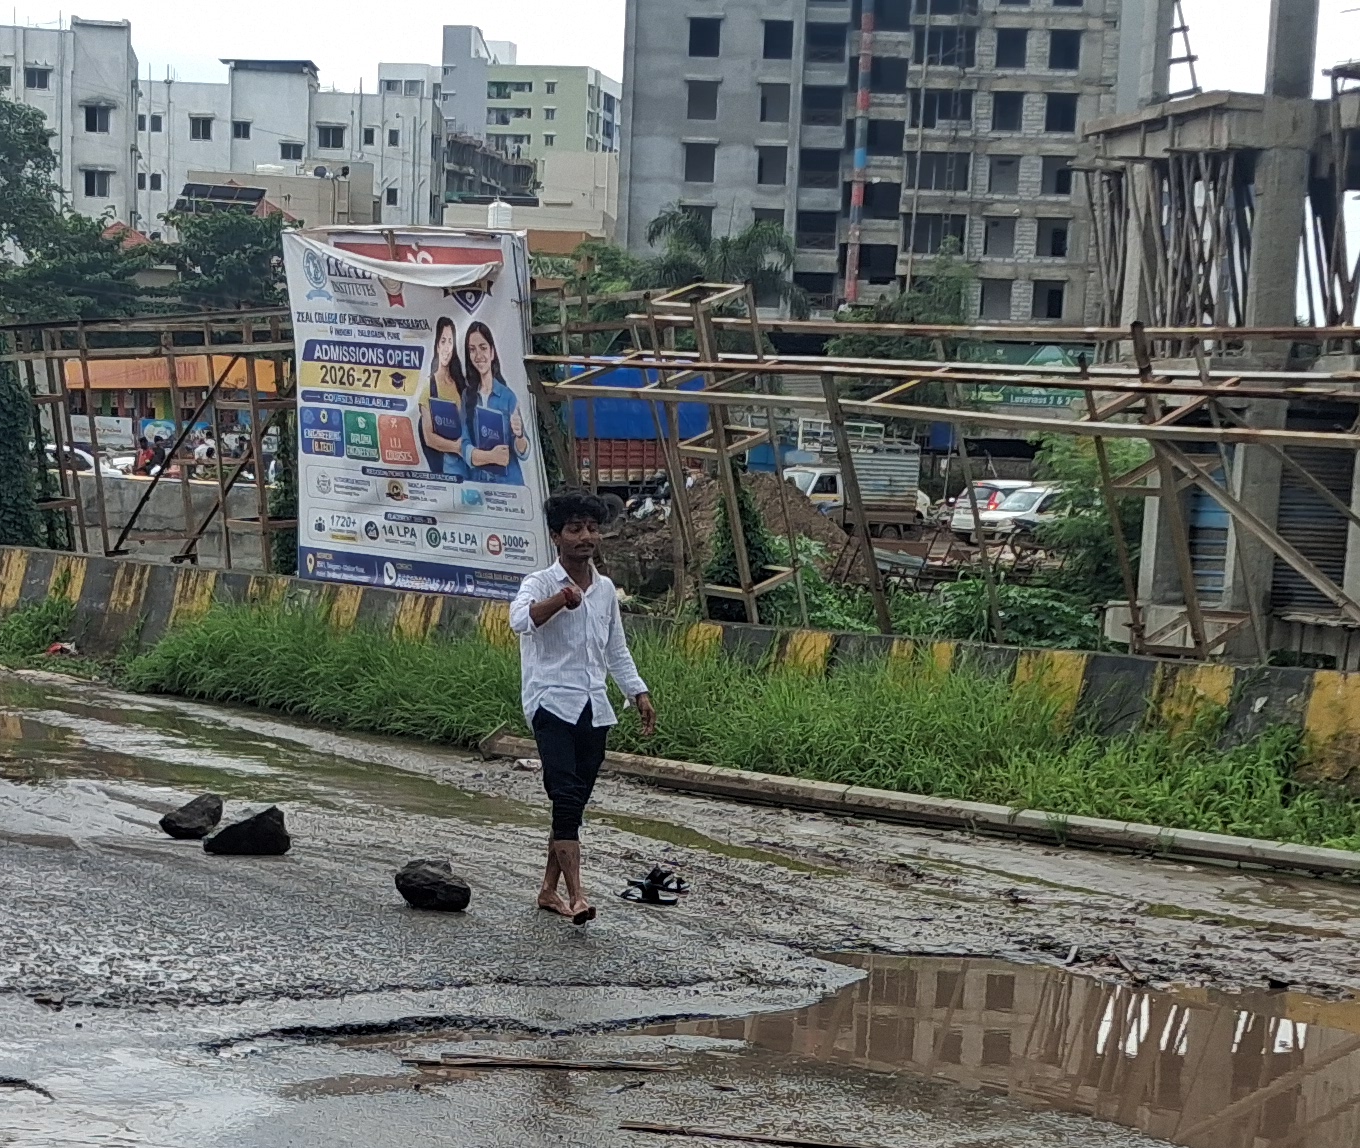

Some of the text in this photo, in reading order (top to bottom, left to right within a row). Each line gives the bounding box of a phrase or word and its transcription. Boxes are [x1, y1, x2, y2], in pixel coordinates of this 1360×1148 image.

[297, 311, 314, 323] ZEAL
[313, 344, 420, 368] ADMISSIONS OPEN
[320, 364, 382, 389] 2026-27
[382, 524, 418, 540] 14 LPA
[458, 532, 478, 547] LPA
